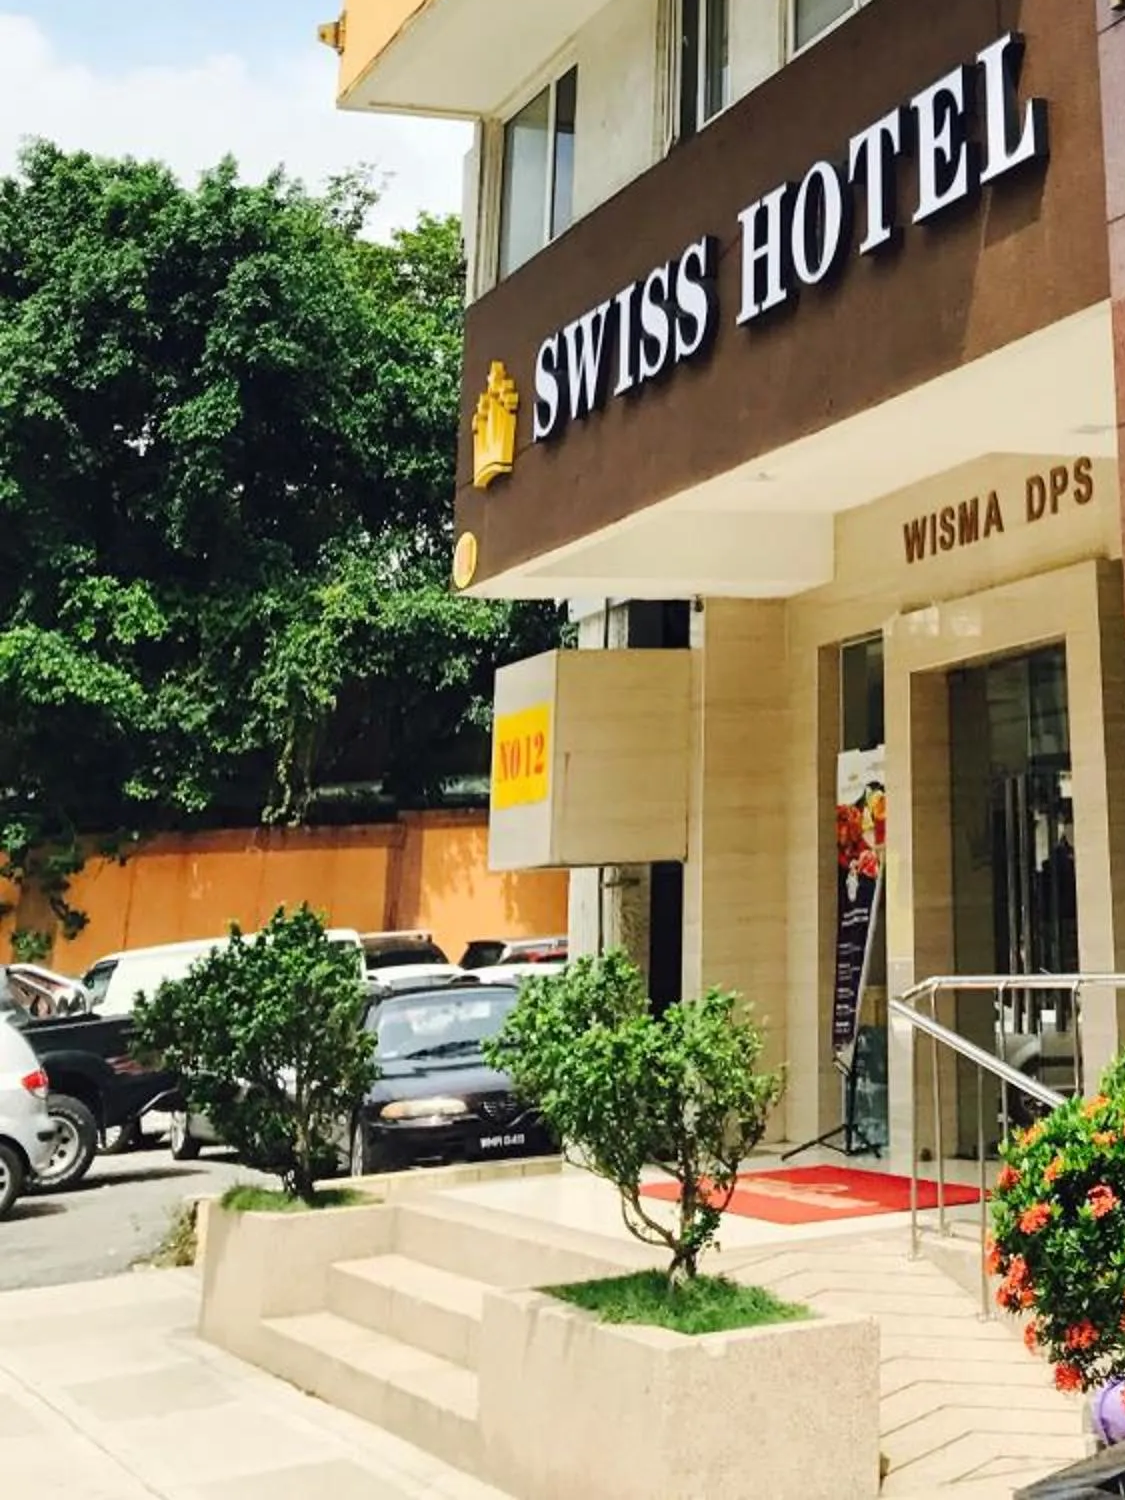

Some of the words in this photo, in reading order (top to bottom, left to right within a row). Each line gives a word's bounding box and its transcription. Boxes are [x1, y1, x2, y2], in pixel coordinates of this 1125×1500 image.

[532, 235, 718, 443] SWISS
[735, 31, 1049, 327] HOTEL
[903, 490, 1004, 564] WISMA
[1025, 456, 1094, 524] DPS
